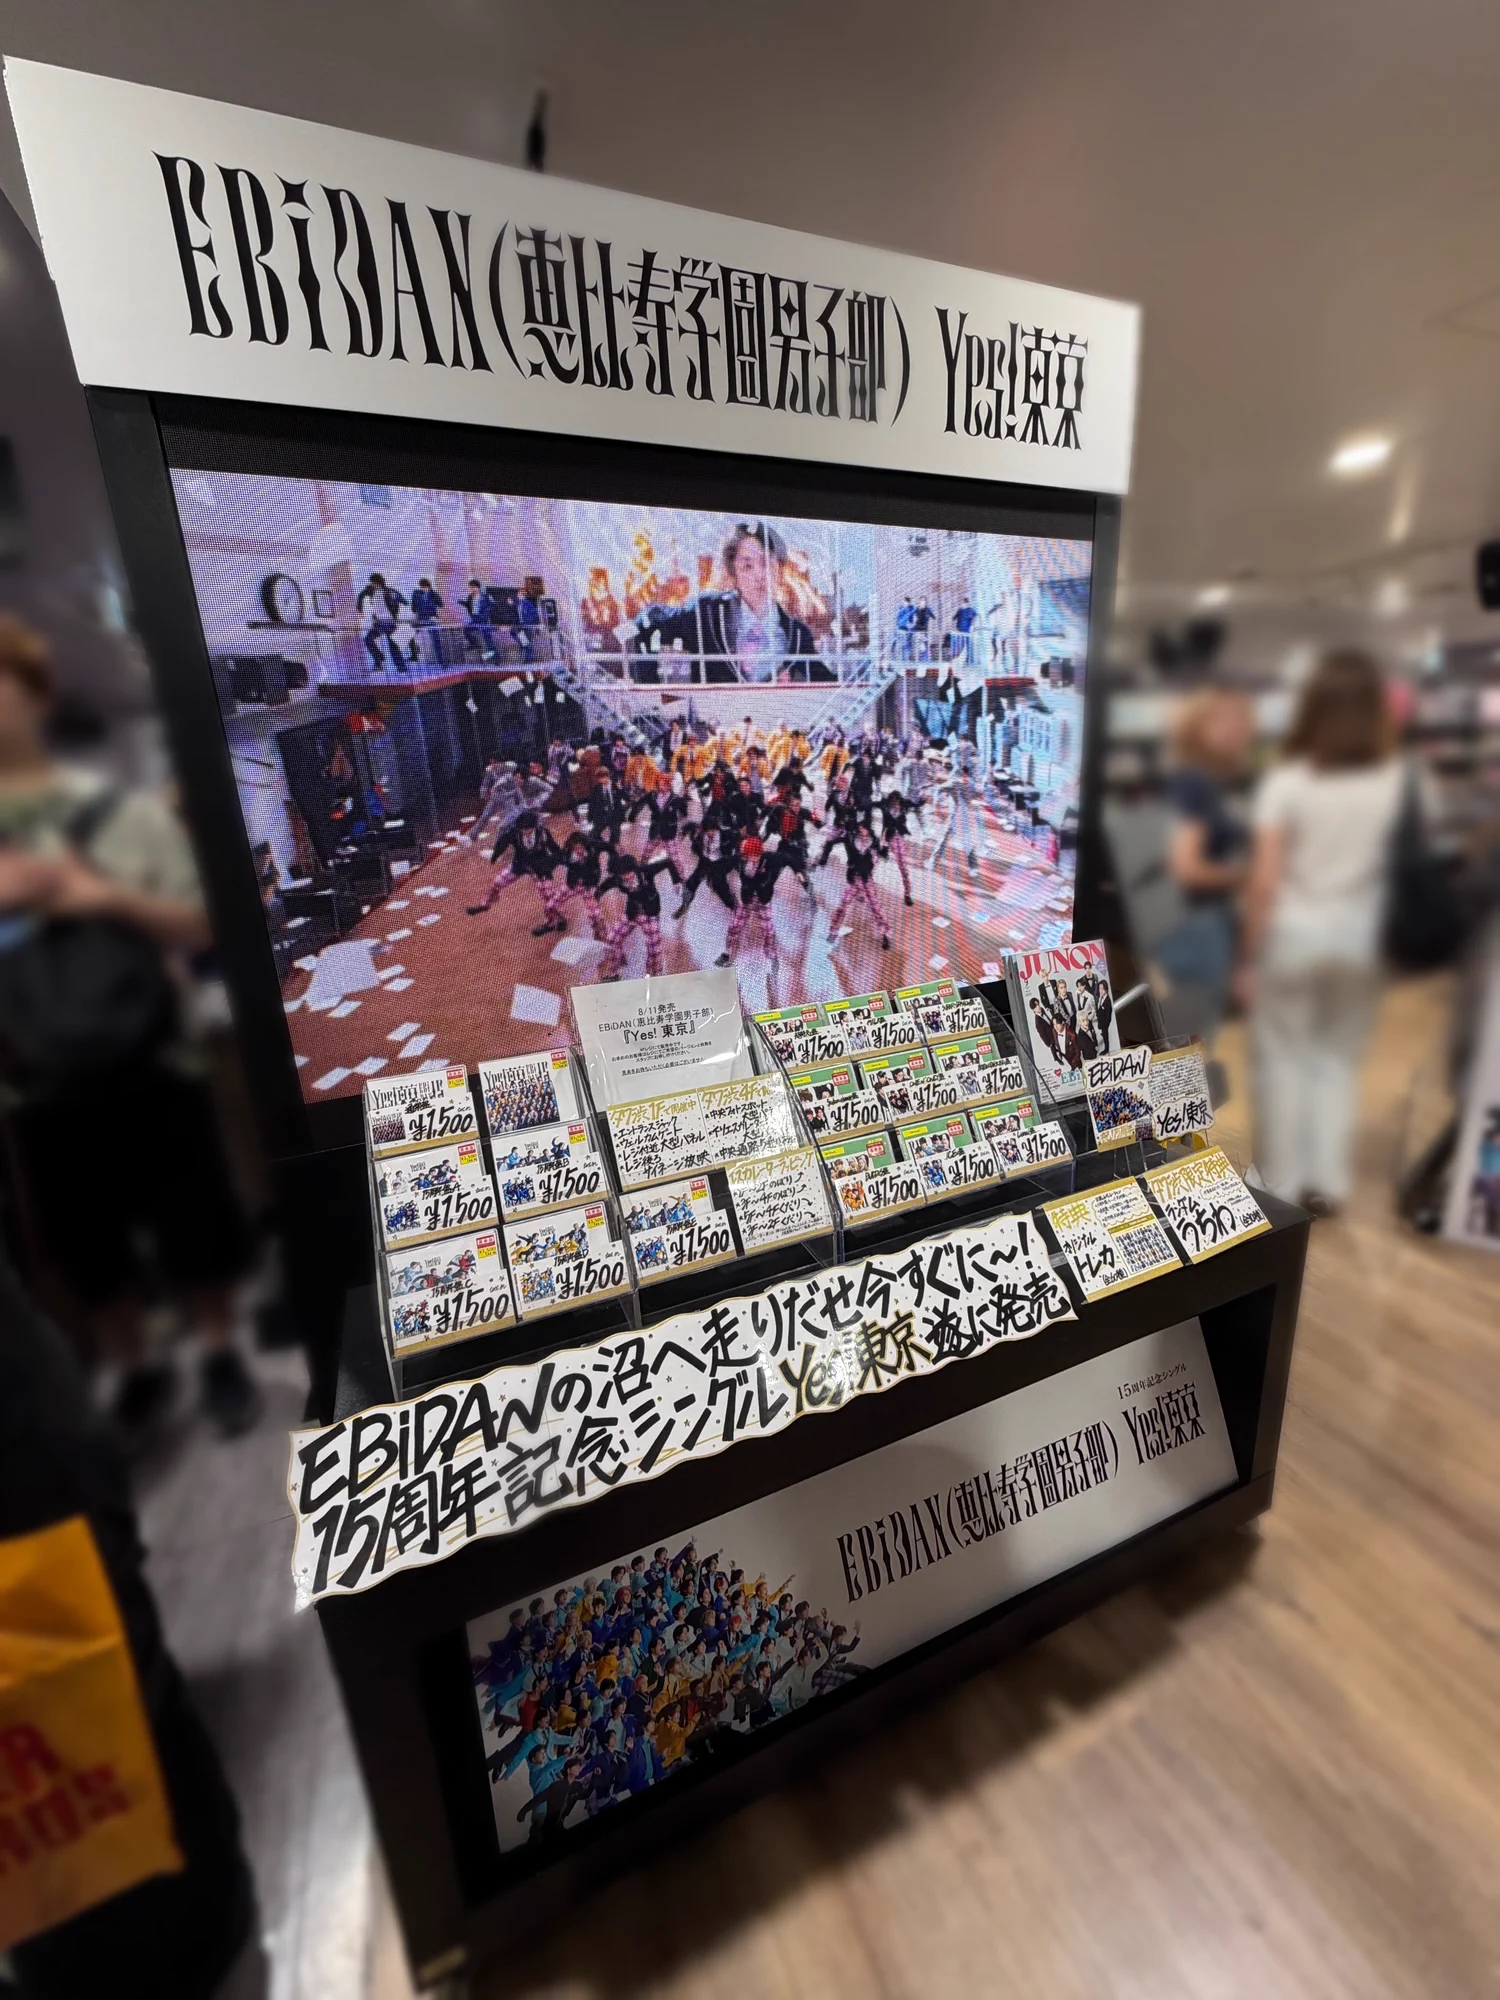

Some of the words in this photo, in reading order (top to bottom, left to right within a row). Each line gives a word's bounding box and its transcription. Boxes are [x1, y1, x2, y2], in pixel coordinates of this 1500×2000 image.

[1020, 943, 1105, 979] JUNON
[638, 1002, 676, 1016] 8/11発売
[1088, 1050, 1147, 1087] EBiDAN
[408, 1106, 474, 1142] ¥1,500
[1157, 1099, 1213, 1136] Yes!東京
[539, 1166, 600, 1204] ¥1,500
[424, 1192, 493, 1230] ¥1,500
[1051, 1203, 1092, 1232] 特典
[1176, 1202, 1237, 1252] うちわ
[670, 1224, 730, 1265] ¥1,500
[556, 1258, 624, 1300] ¥1,500
[1073, 1244, 1115, 1283] トレカ
[433, 1288, 509, 1334] ¥1,500
[1117, 1363, 1188, 1400] 15周年記念シングル
